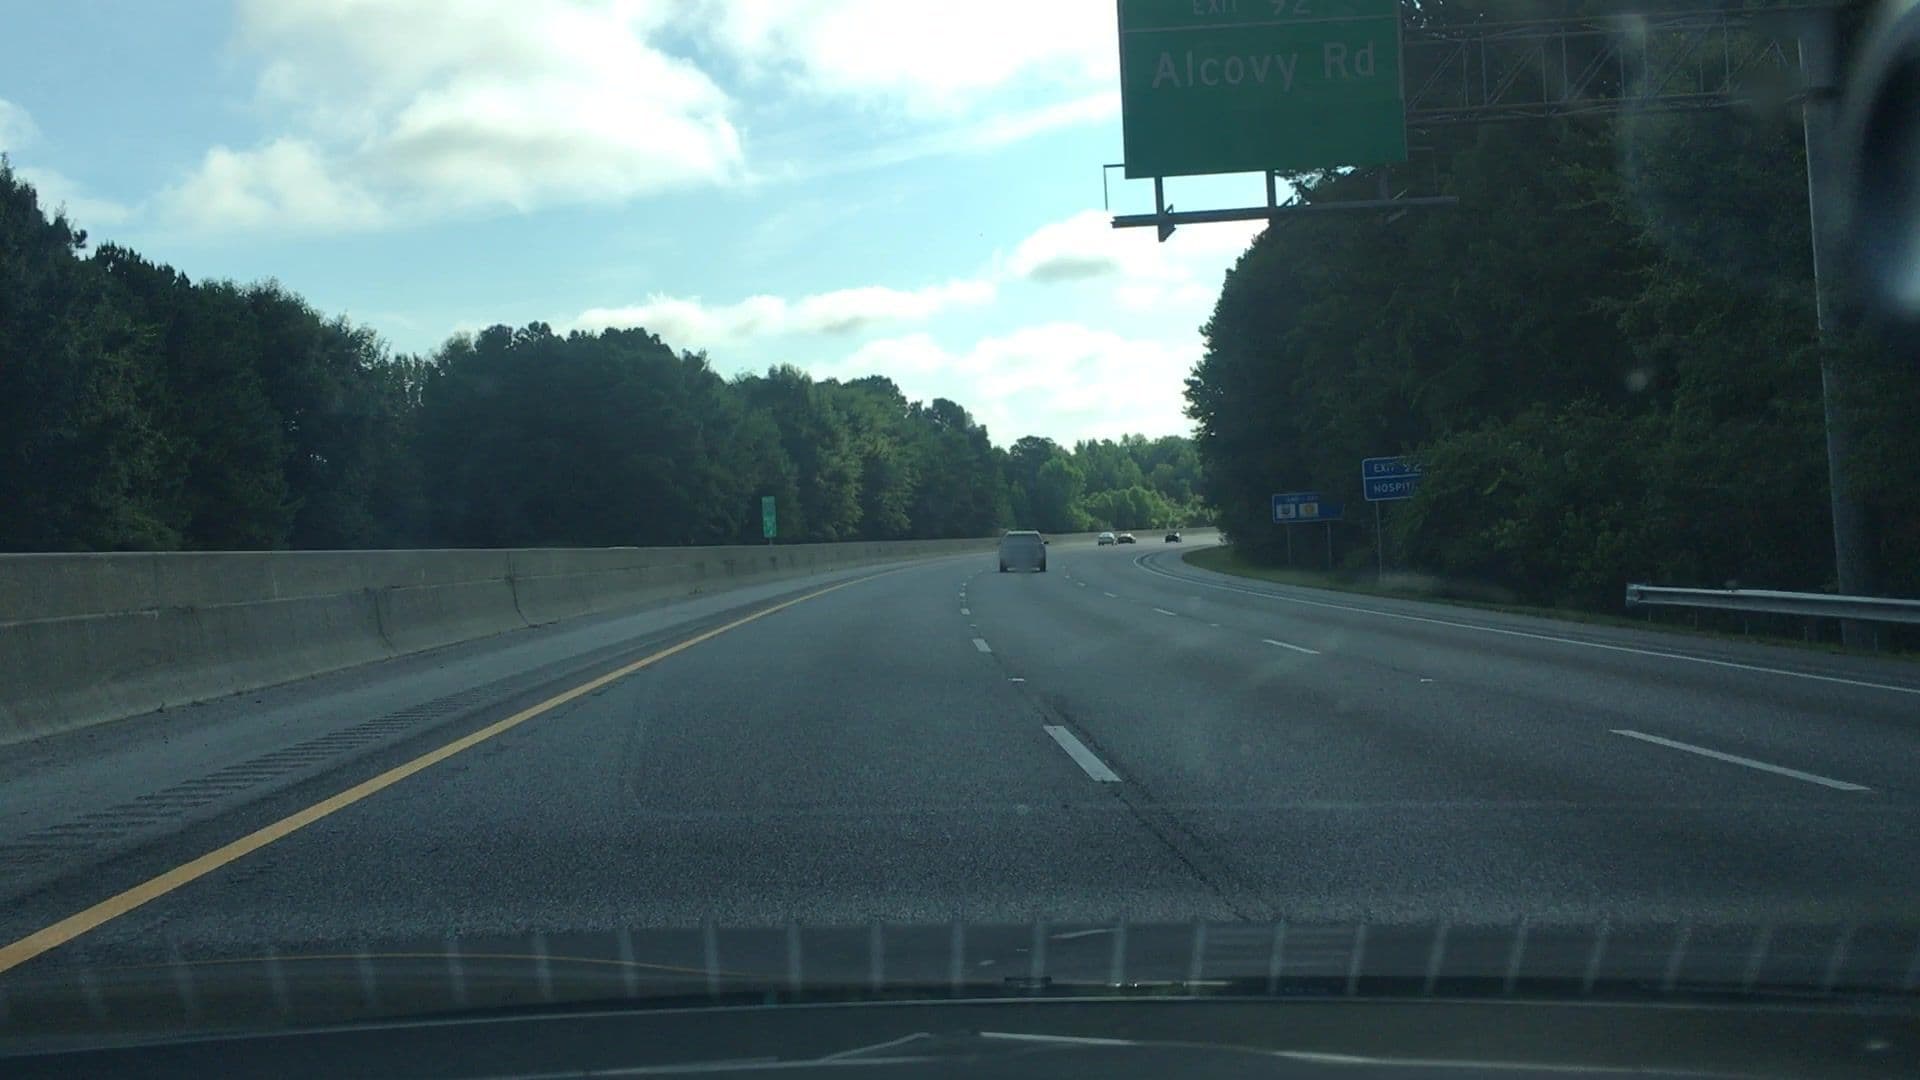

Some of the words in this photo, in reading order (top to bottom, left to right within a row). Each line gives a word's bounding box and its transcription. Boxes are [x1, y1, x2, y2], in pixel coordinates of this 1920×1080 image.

[1193, 0, 1238, 16] EXIT
[1151, 49, 1298, 92] Alcovy
[1324, 40, 1376, 80] Rd
